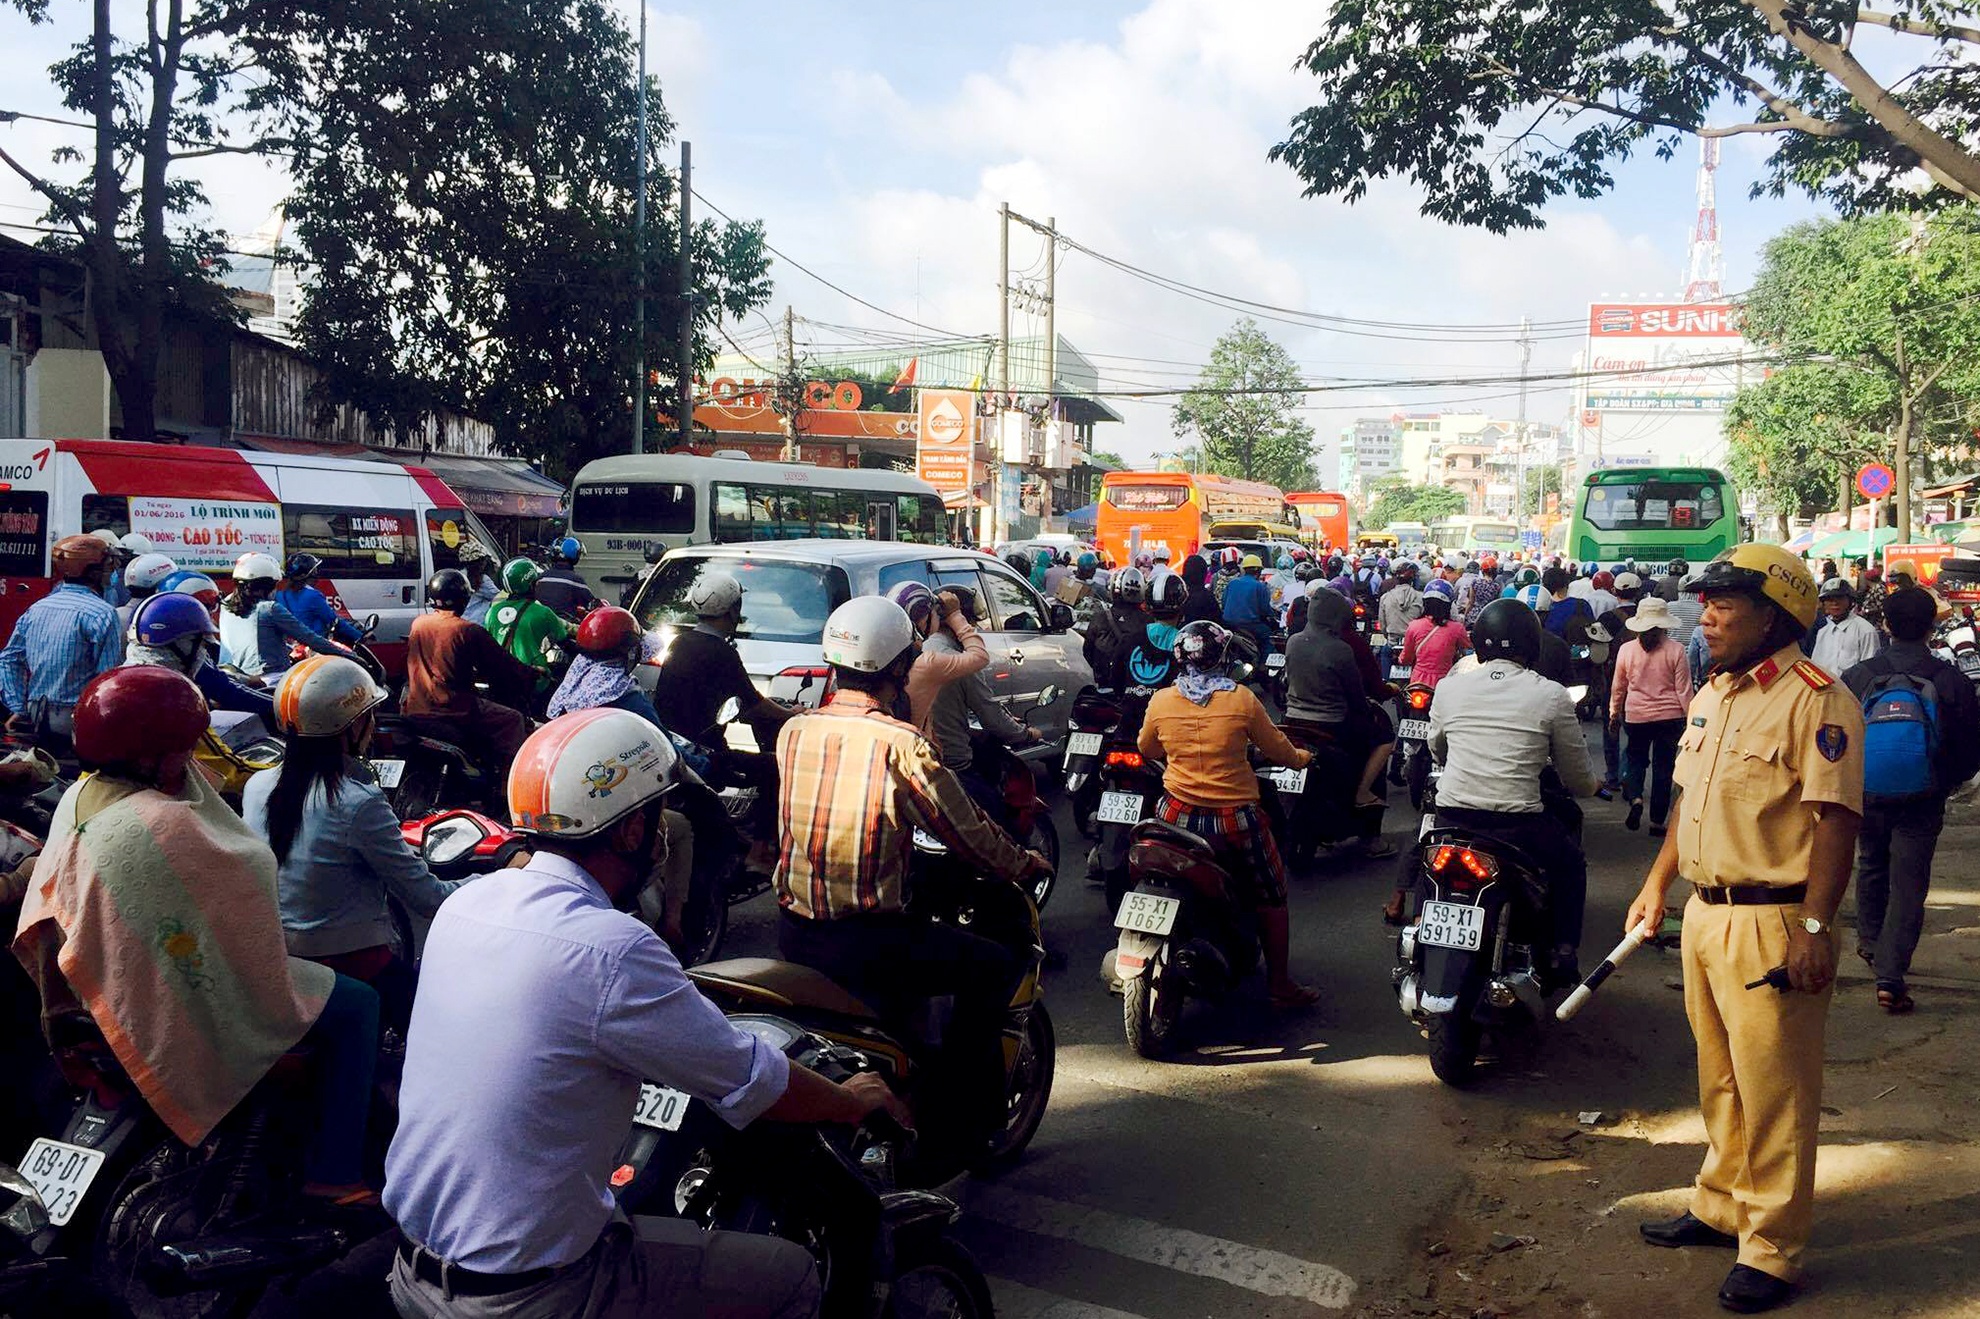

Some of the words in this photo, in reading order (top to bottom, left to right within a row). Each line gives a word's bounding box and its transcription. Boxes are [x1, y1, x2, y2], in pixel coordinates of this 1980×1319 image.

[925, 470, 964, 479] COMECO
[191, 504, 207, 520] LỘ
[211, 504, 249, 519] TRÌNH
[183, 527, 210, 545] CAO
[215, 520, 243, 545] TỐC
[359, 536, 376, 549] CAO
[1768, 564, 1809, 597] CSGT
[619, 740, 651, 762] Strepsils
[1108, 795, 1137, 809] 59-S2
[1101, 807, 1138, 821] 512.60
[1129, 896, 1169, 915] 55-X1
[1126, 911, 1166, 931] 1067
[1432, 905, 1473, 927] 59-X1
[1423, 923, 1478, 947] 591.59
